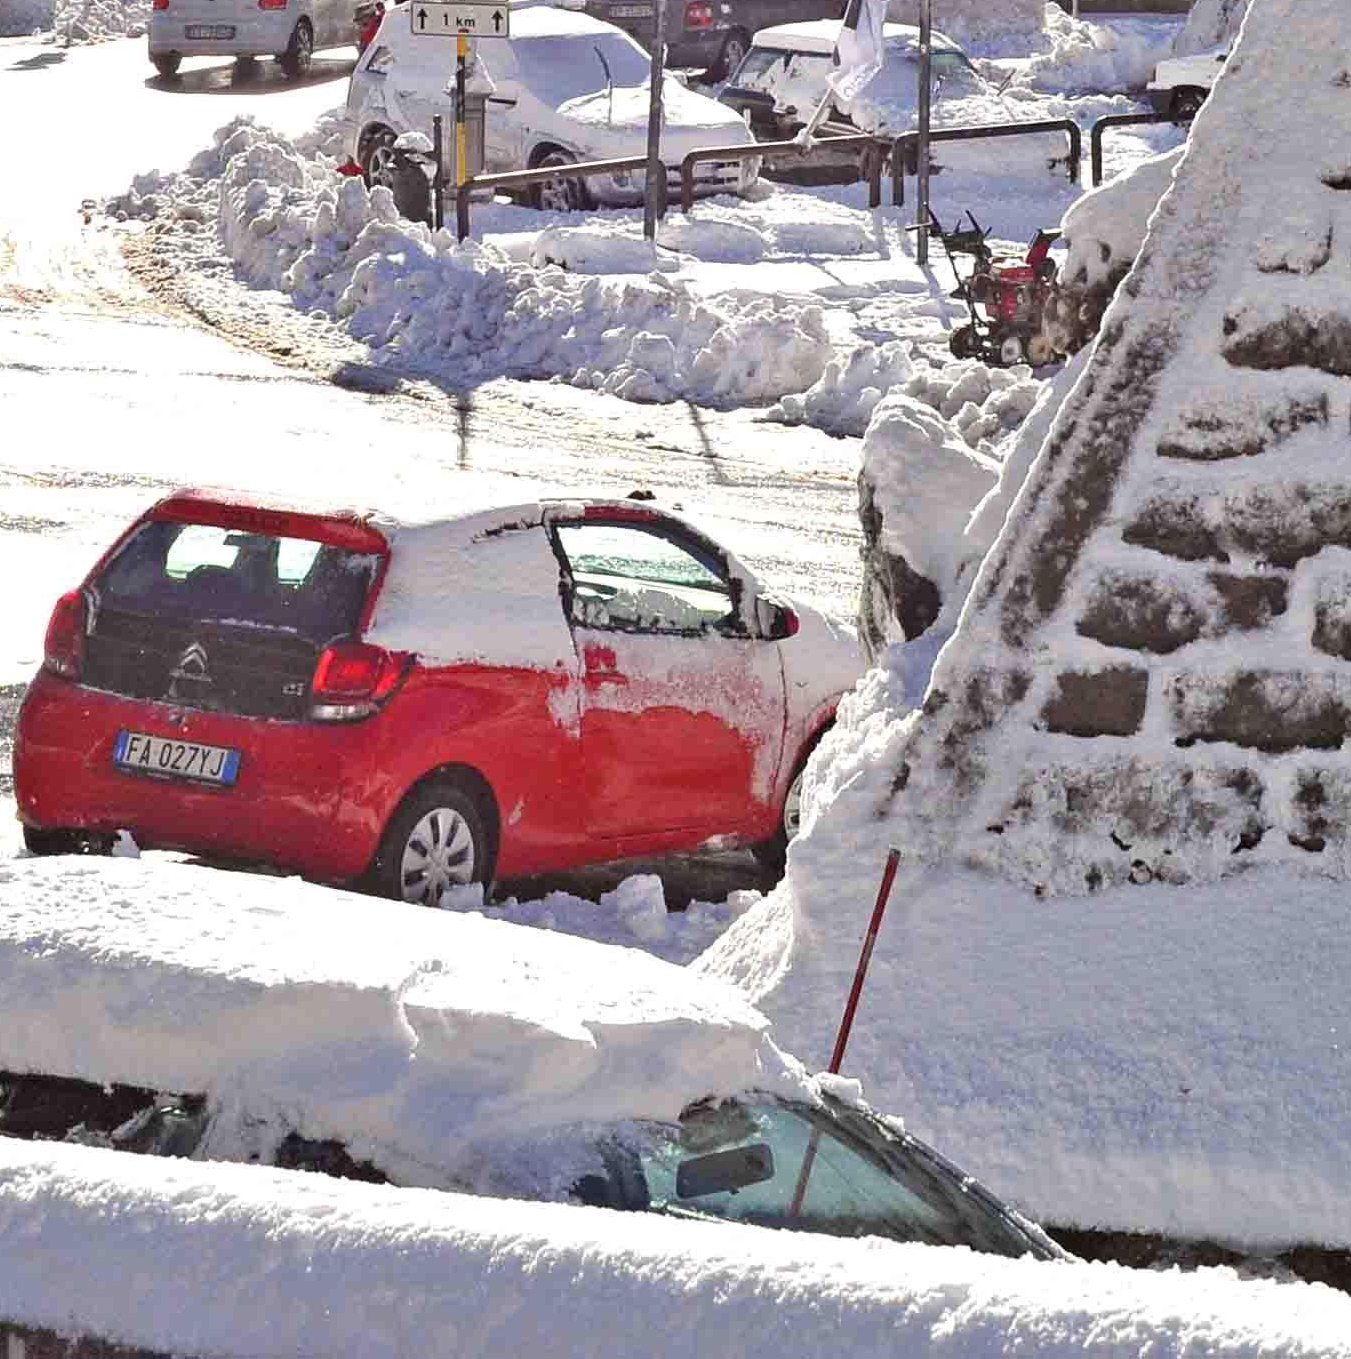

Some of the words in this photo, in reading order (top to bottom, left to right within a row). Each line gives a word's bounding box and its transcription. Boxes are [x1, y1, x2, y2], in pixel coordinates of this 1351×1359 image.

[442, 12, 449, 27] 1
[455, 16, 476, 28] km
[125, 736, 151, 767] FA
[158, 742, 226, 777] 027YJ
